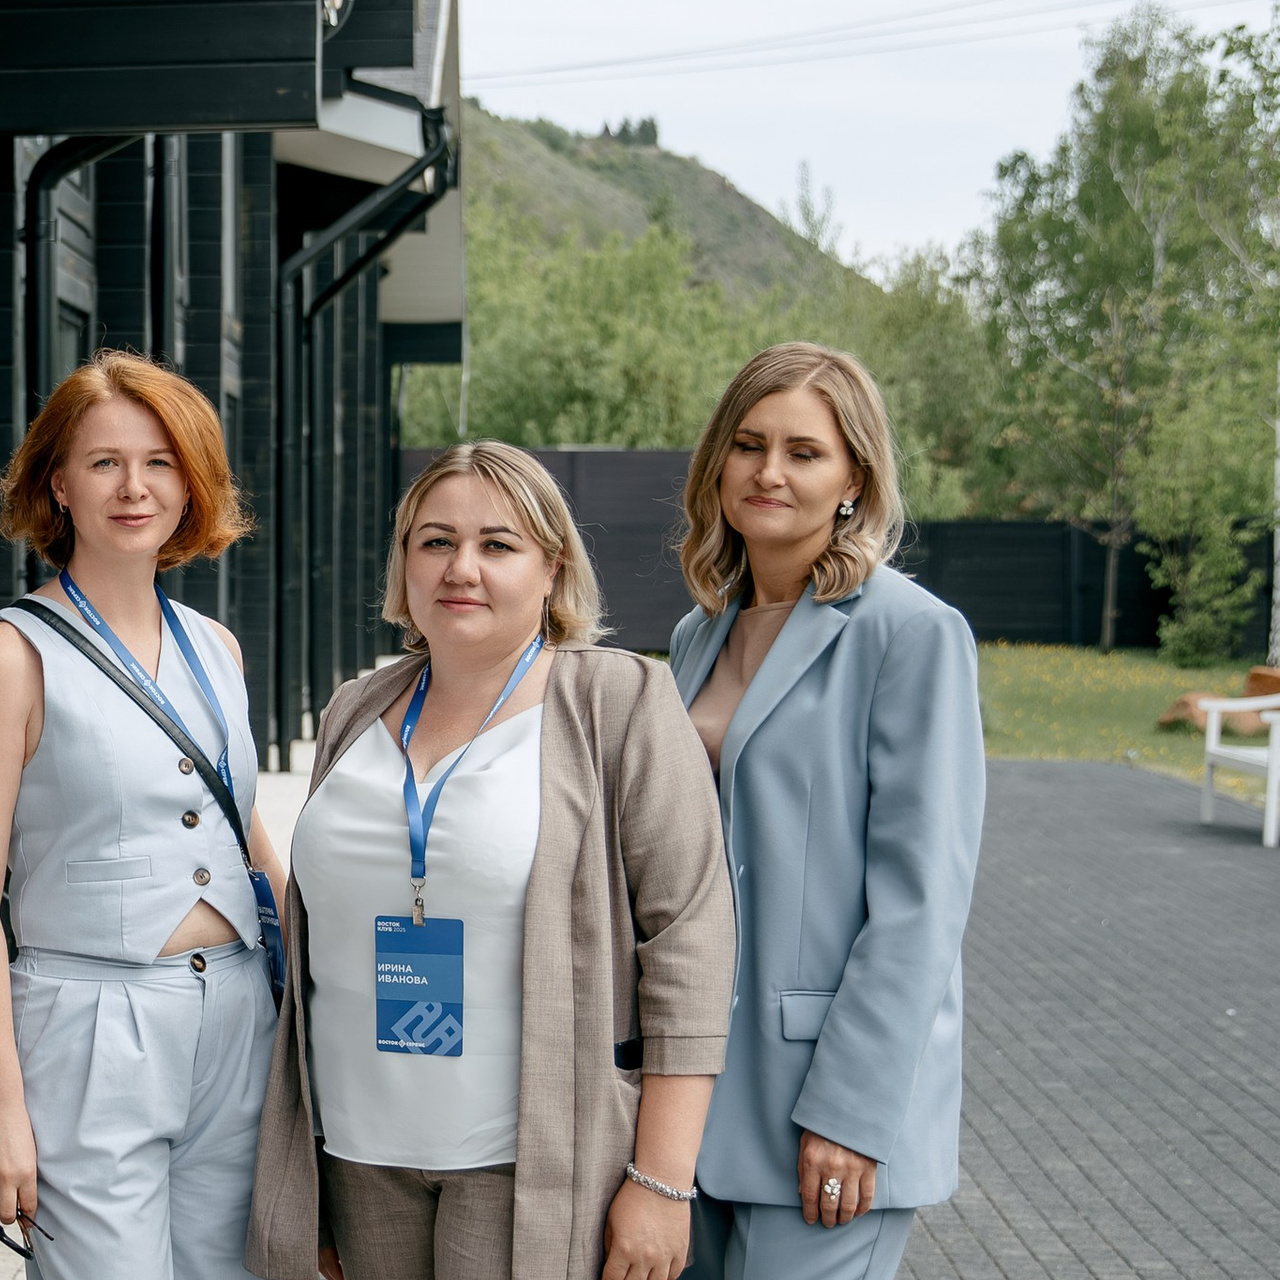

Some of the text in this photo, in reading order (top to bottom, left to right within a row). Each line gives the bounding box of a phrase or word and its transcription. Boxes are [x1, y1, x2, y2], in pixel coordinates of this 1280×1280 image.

[68, 585, 100, 625] ВОСТОК СЕРВИС
[130, 663, 165, 704] ВОСТОК СЕРВИС
[377, 963, 413, 973] ИРИНА
[377, 974, 428, 985] ИВАНОВА
